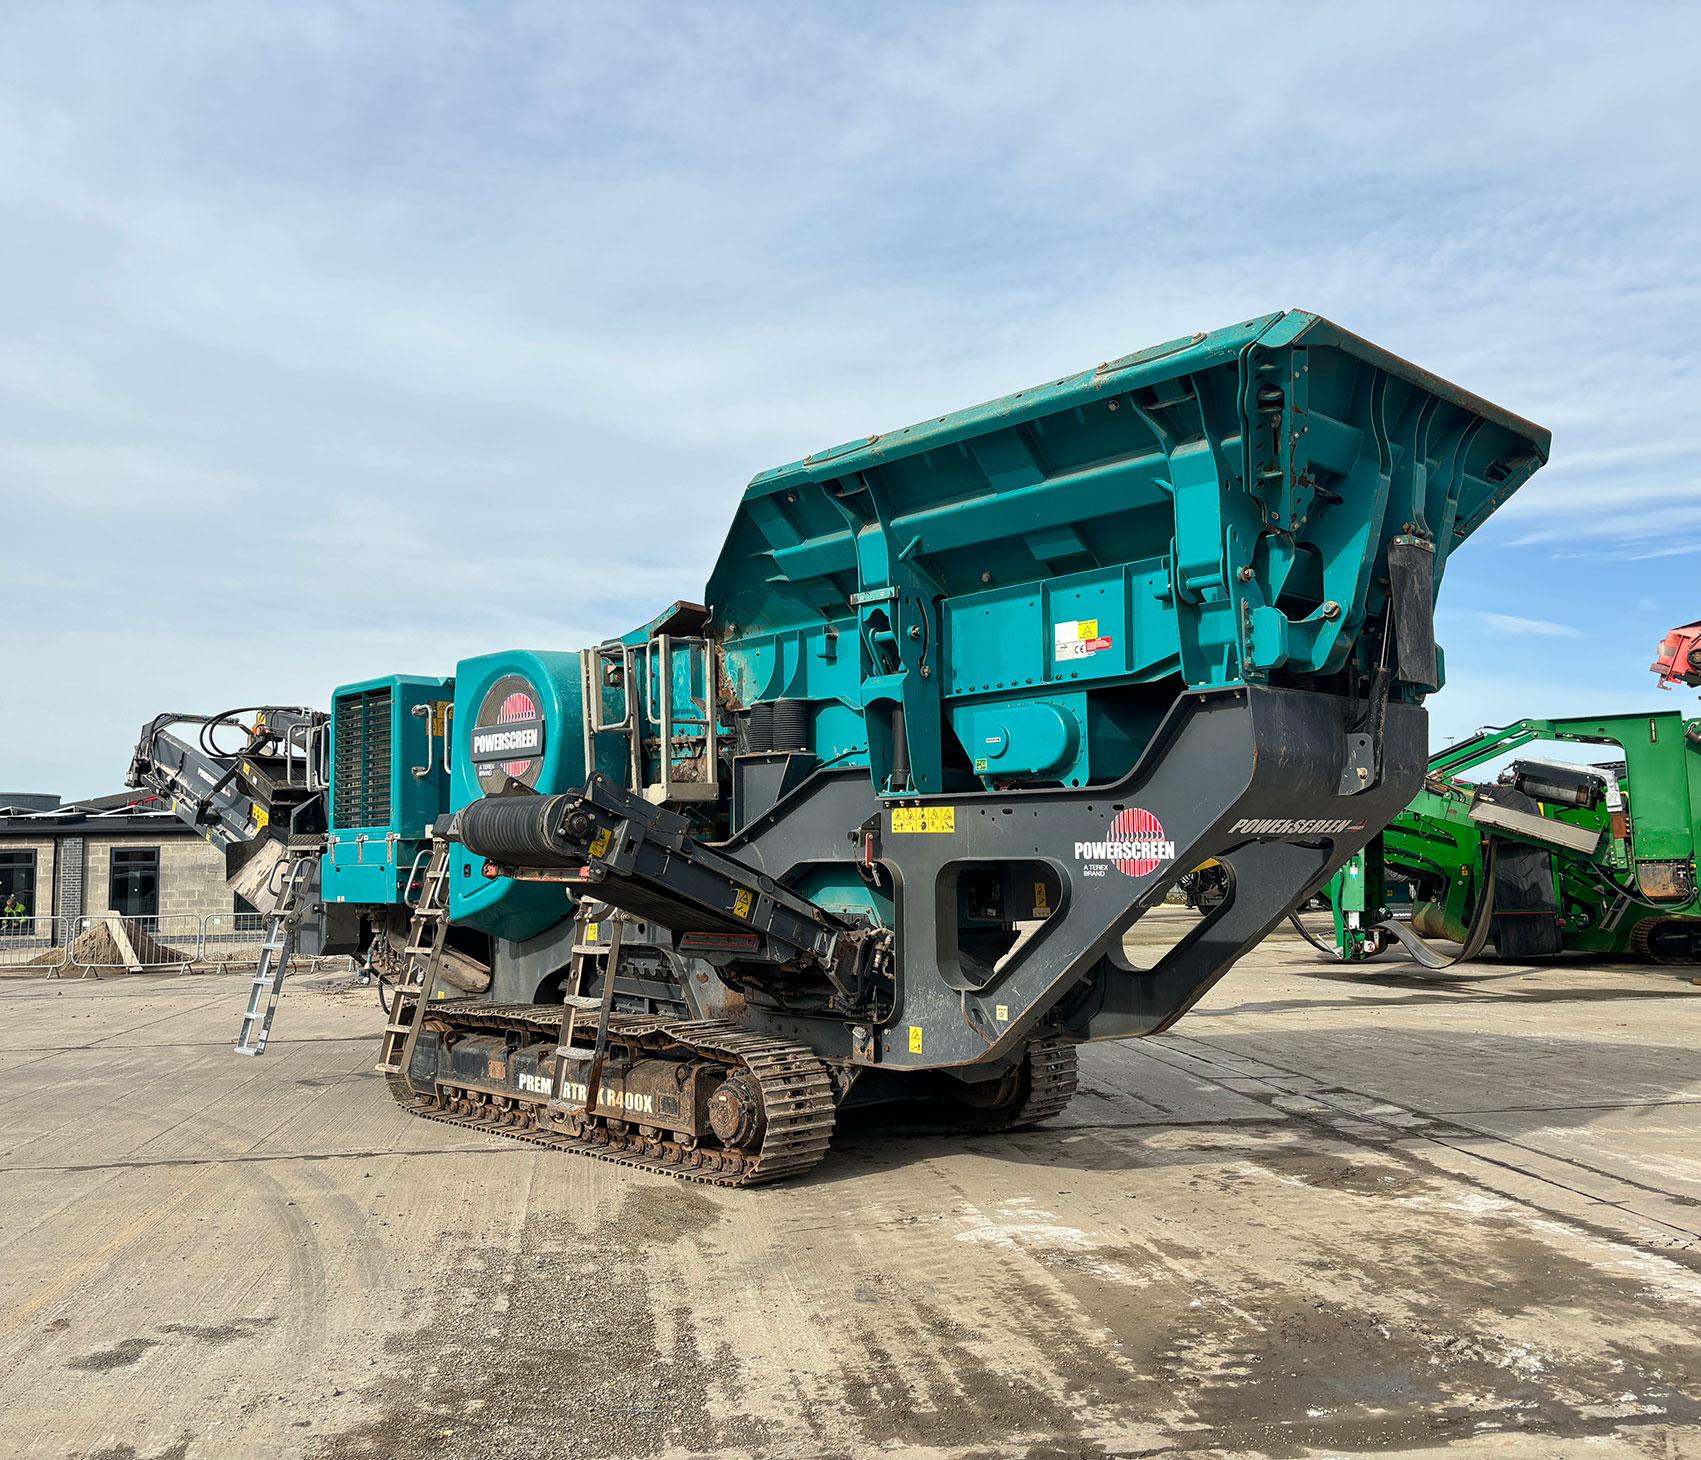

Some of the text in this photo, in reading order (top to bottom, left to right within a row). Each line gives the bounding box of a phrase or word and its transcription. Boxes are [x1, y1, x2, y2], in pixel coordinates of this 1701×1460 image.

[474, 728, 538, 754] POWERSCREEN
[1227, 819, 1352, 834] POWERSCREEN
[1074, 841, 1175, 860] POWERSCREEN
[607, 1087, 653, 1114] R400X
